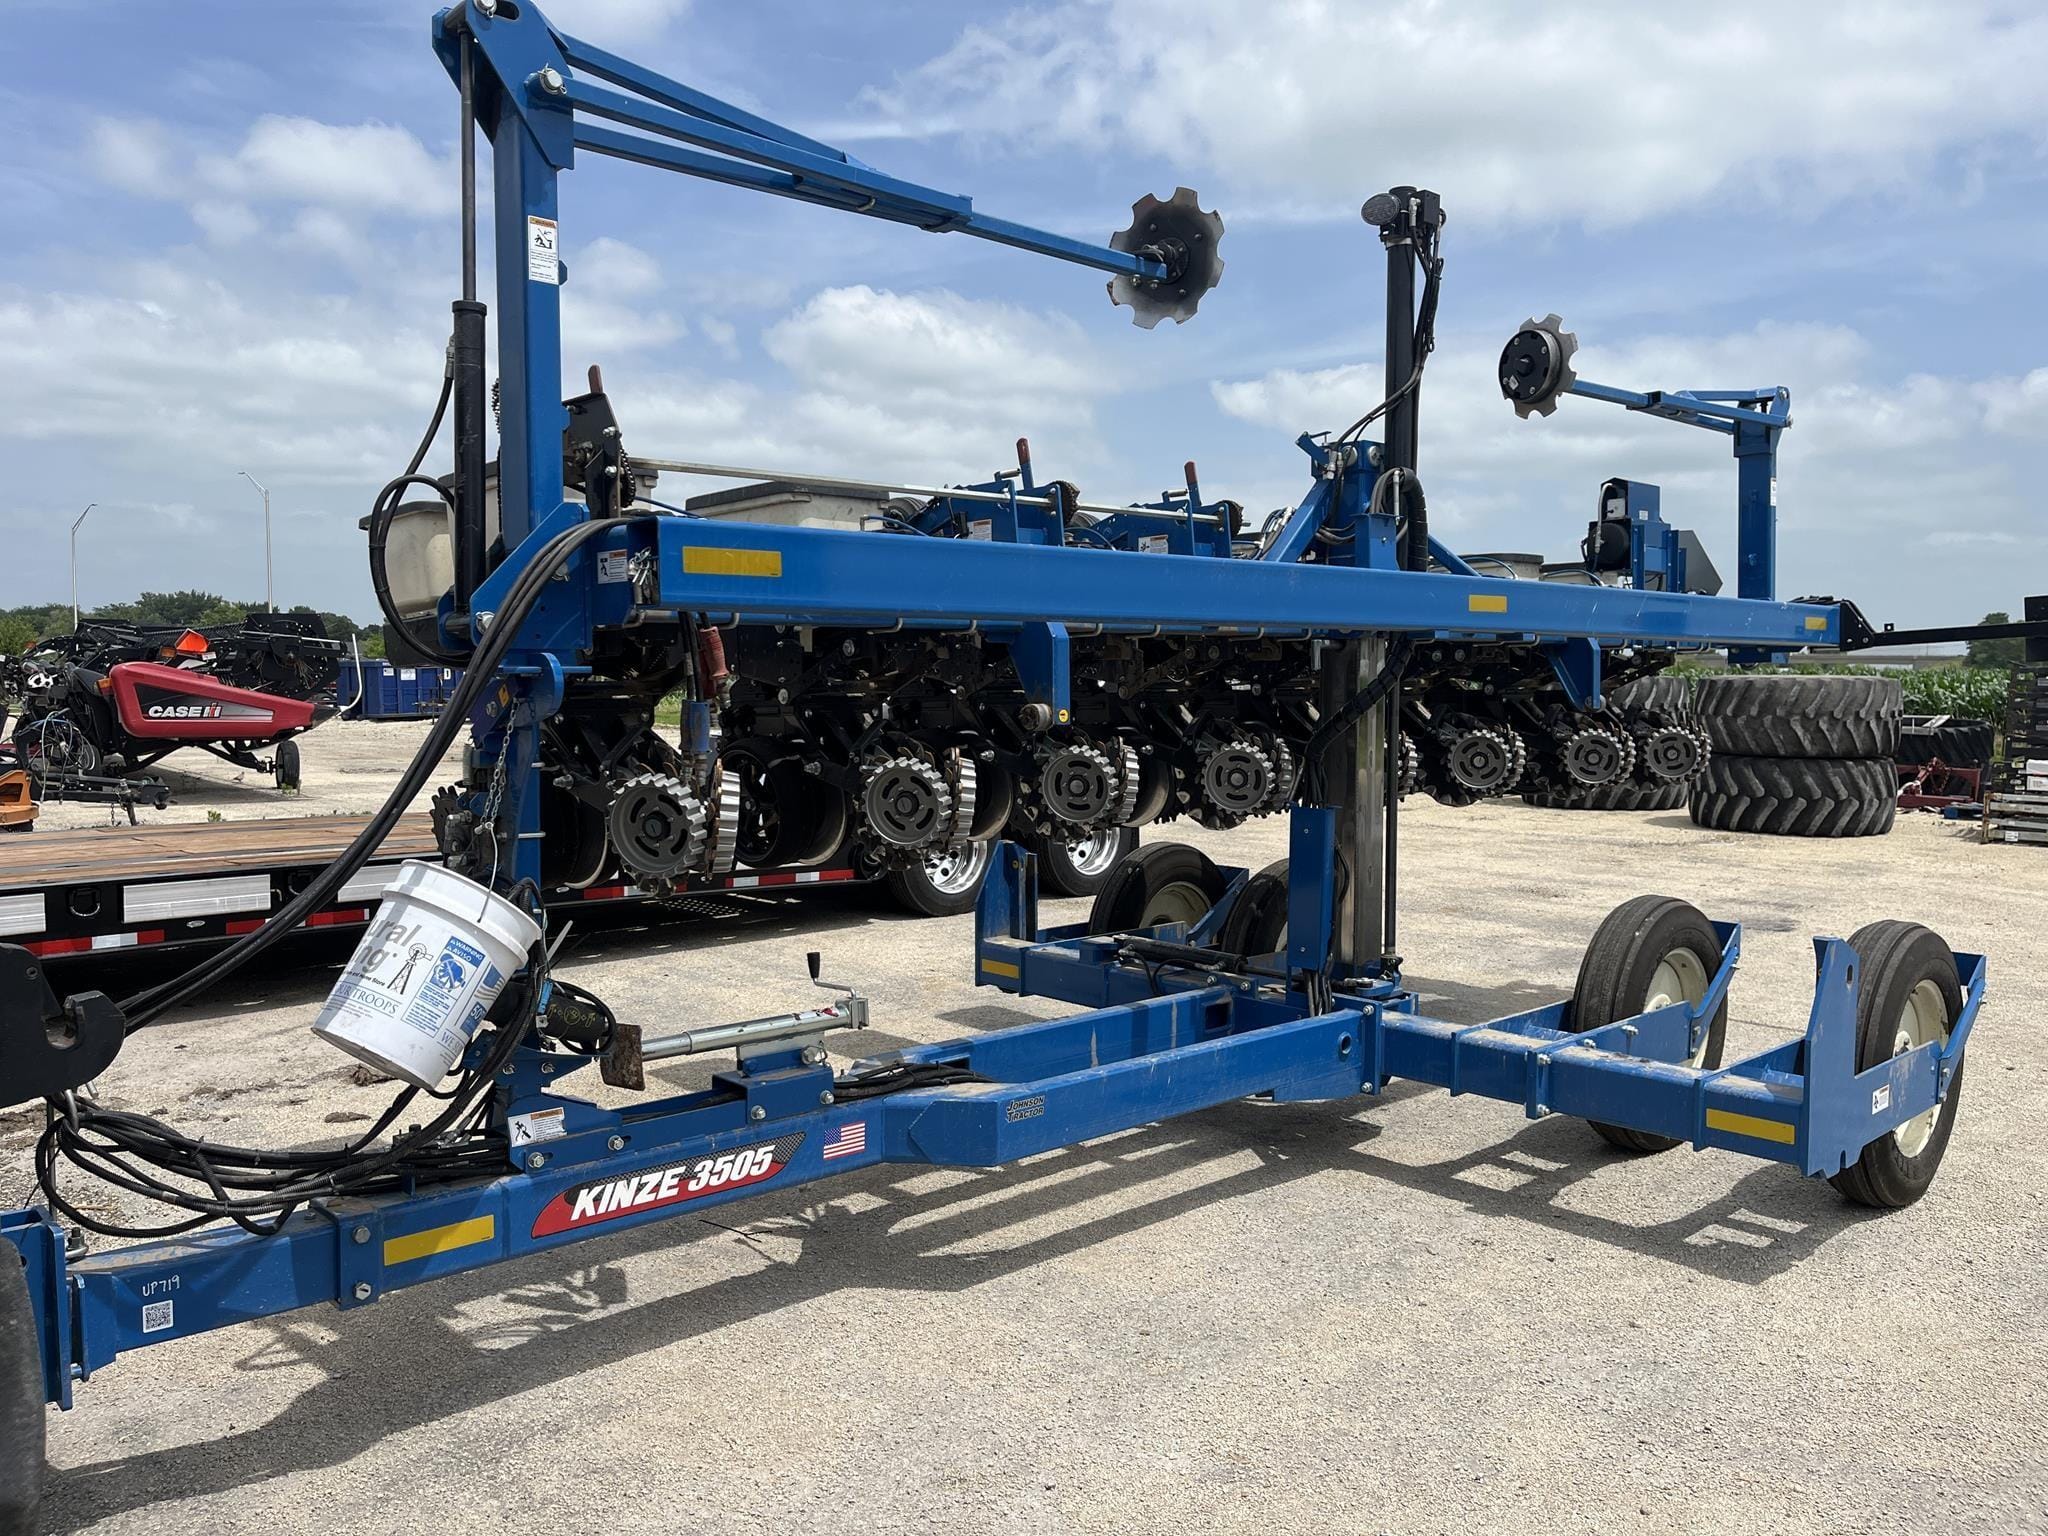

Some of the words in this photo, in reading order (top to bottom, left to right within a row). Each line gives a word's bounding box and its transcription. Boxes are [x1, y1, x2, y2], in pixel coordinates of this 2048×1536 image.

[149, 706, 199, 718] CASE
[366, 918, 423, 947] ural
[350, 938, 391, 974] ing
[455, 940, 484, 961] WARNING
[352, 987, 399, 1014] TROOPS
[1007, 1096, 1044, 1111] JOHNSON
[1007, 1107, 1043, 1121] TRACTOR
[570, 1165, 686, 1221] KINZE
[687, 1145, 776, 1192] 3505
[142, 1274, 180, 1297] UP719
